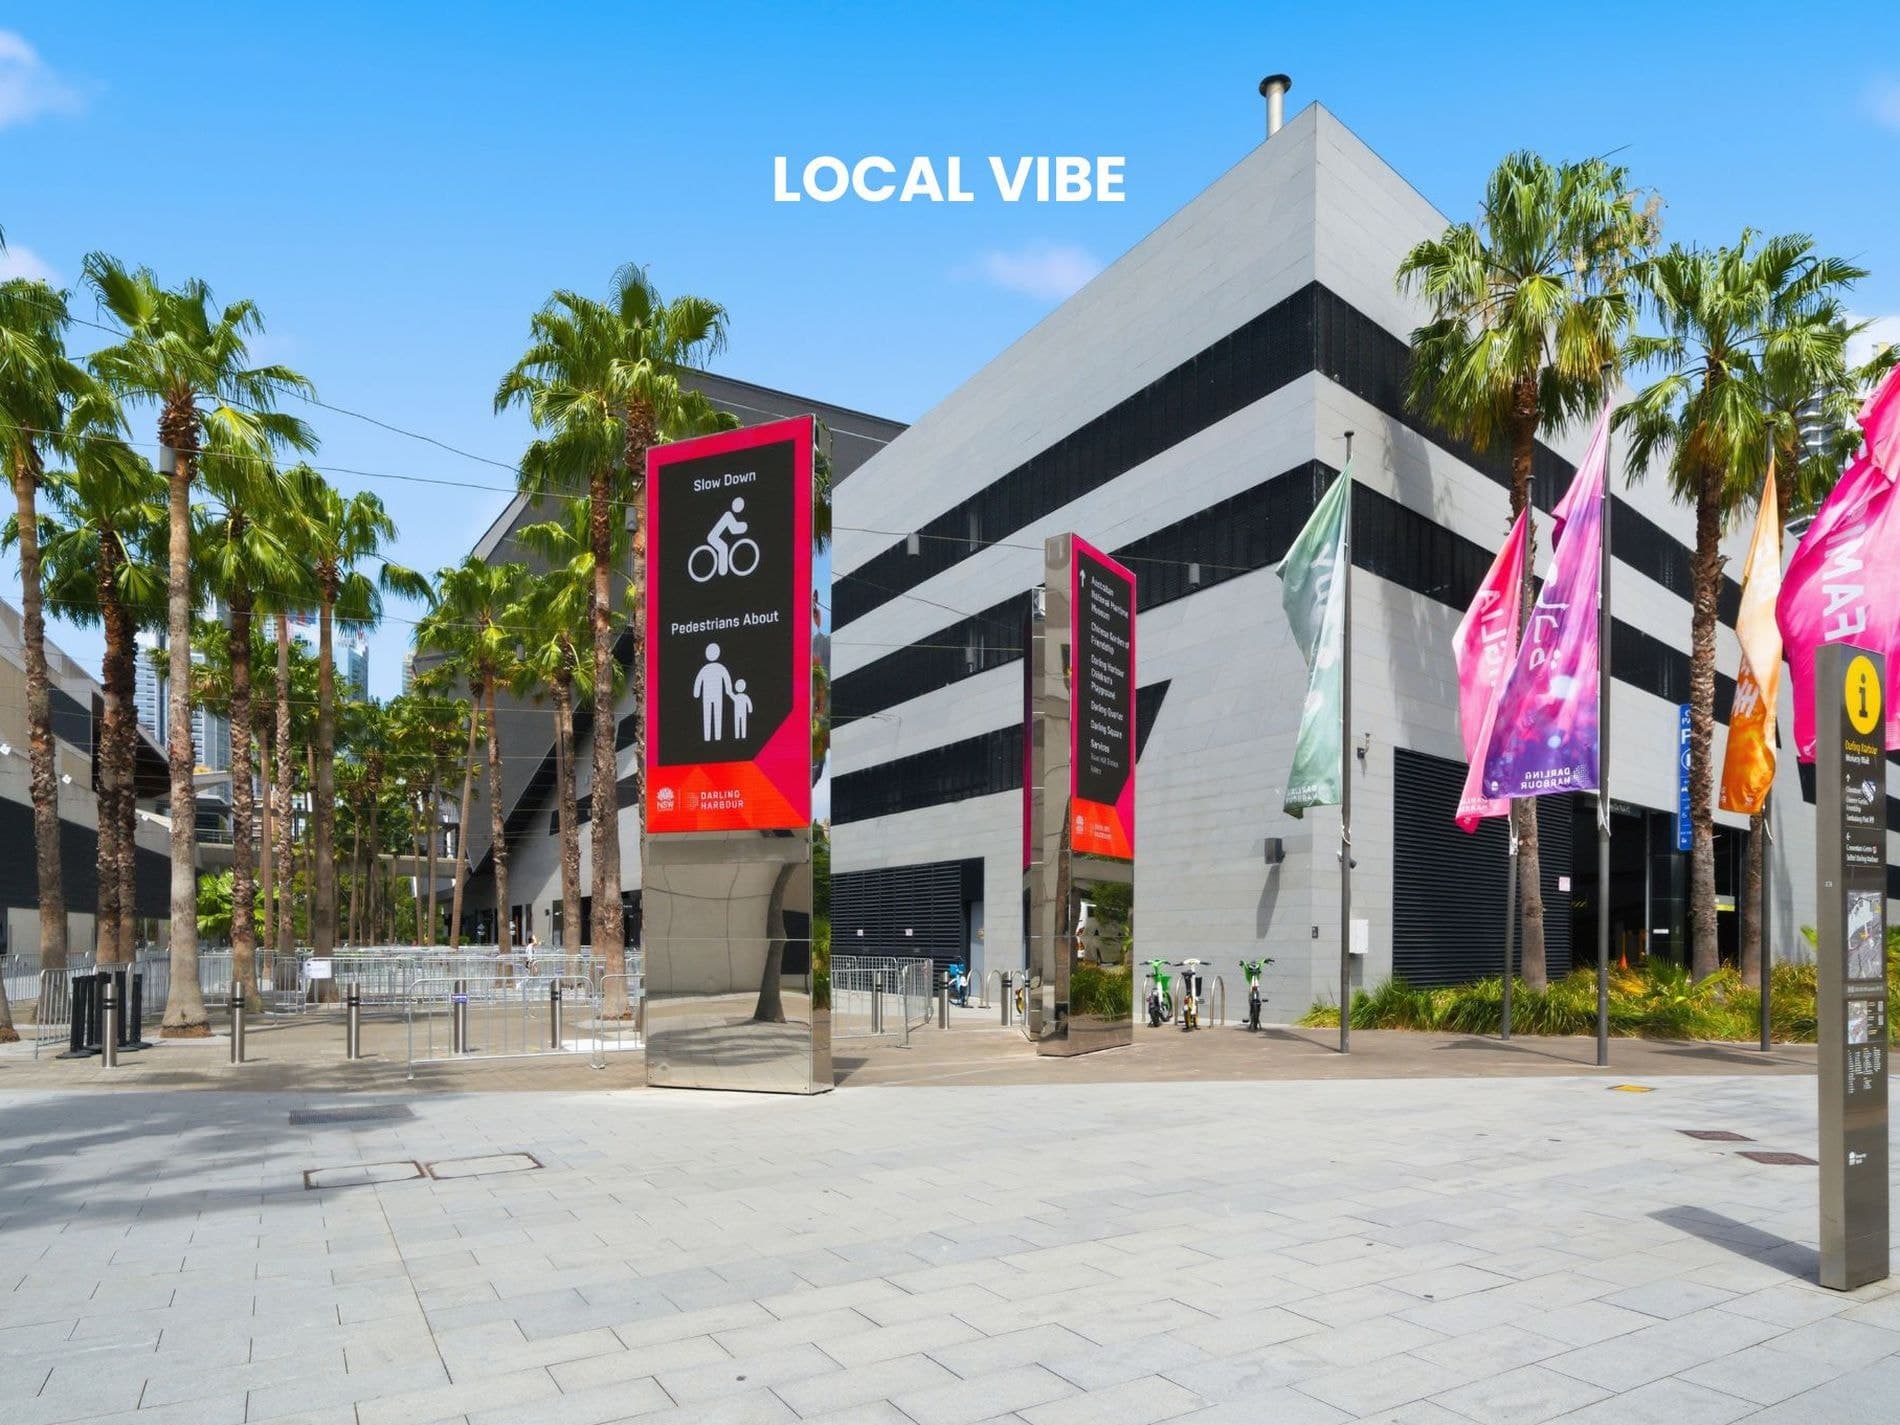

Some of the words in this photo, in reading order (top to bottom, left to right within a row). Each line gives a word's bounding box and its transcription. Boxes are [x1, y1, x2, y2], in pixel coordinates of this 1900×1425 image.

[693, 478, 721, 492] Slow
[724, 471, 756, 487] Down
[671, 616, 740, 635] Pedestrians
[743, 610, 779, 625] About
[701, 790, 740, 800] DARLING
[701, 800, 744, 810] HARBOUR
